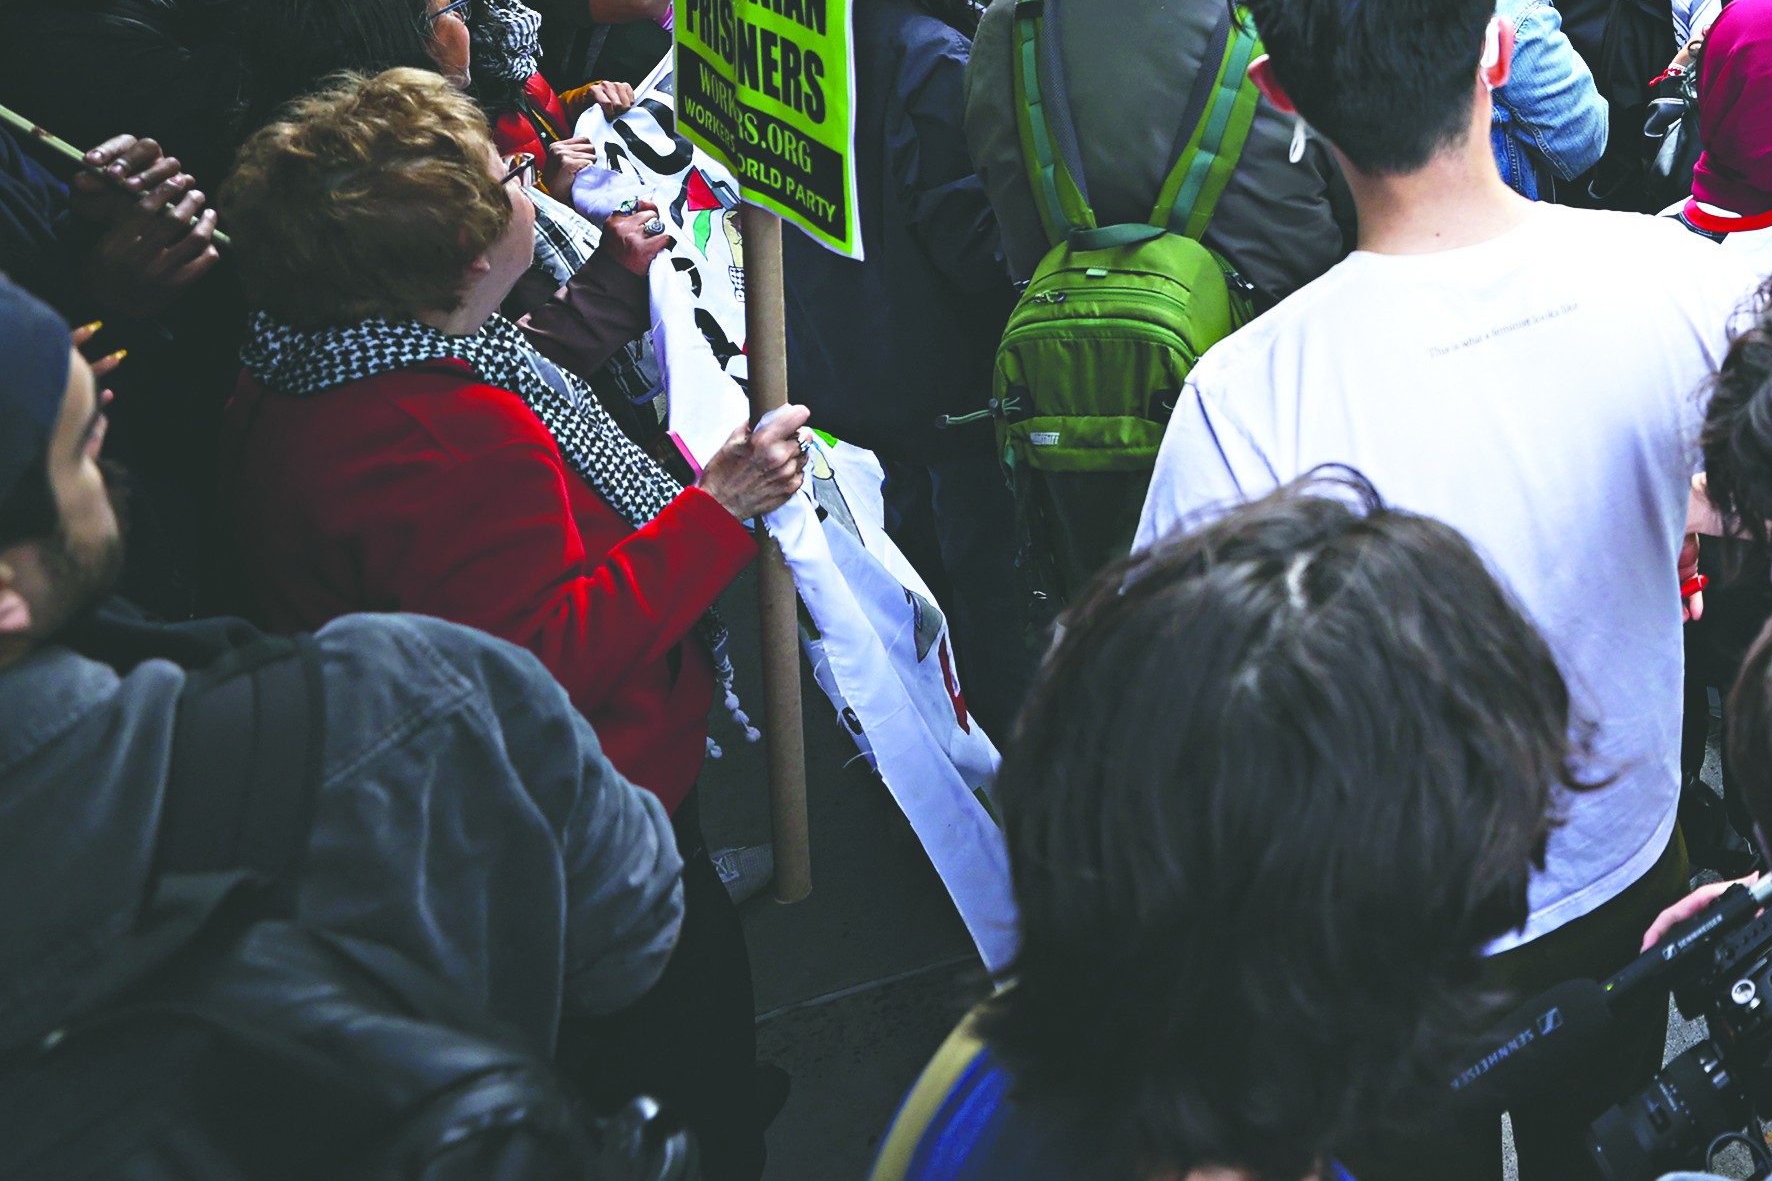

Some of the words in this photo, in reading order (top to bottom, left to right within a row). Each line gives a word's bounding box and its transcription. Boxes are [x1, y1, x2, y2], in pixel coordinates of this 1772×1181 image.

[684, 94, 736, 154] WORKERS
[737, 152, 781, 190] ORLD
[785, 175, 835, 223] PARTY
[700, 62, 812, 174] WORKRS.ORG
[1428, 347, 1449, 358] This
[1462, 335, 1482, 348] what
[1491, 318, 1531, 336] feminist
[1533, 310, 1559, 324] looks
